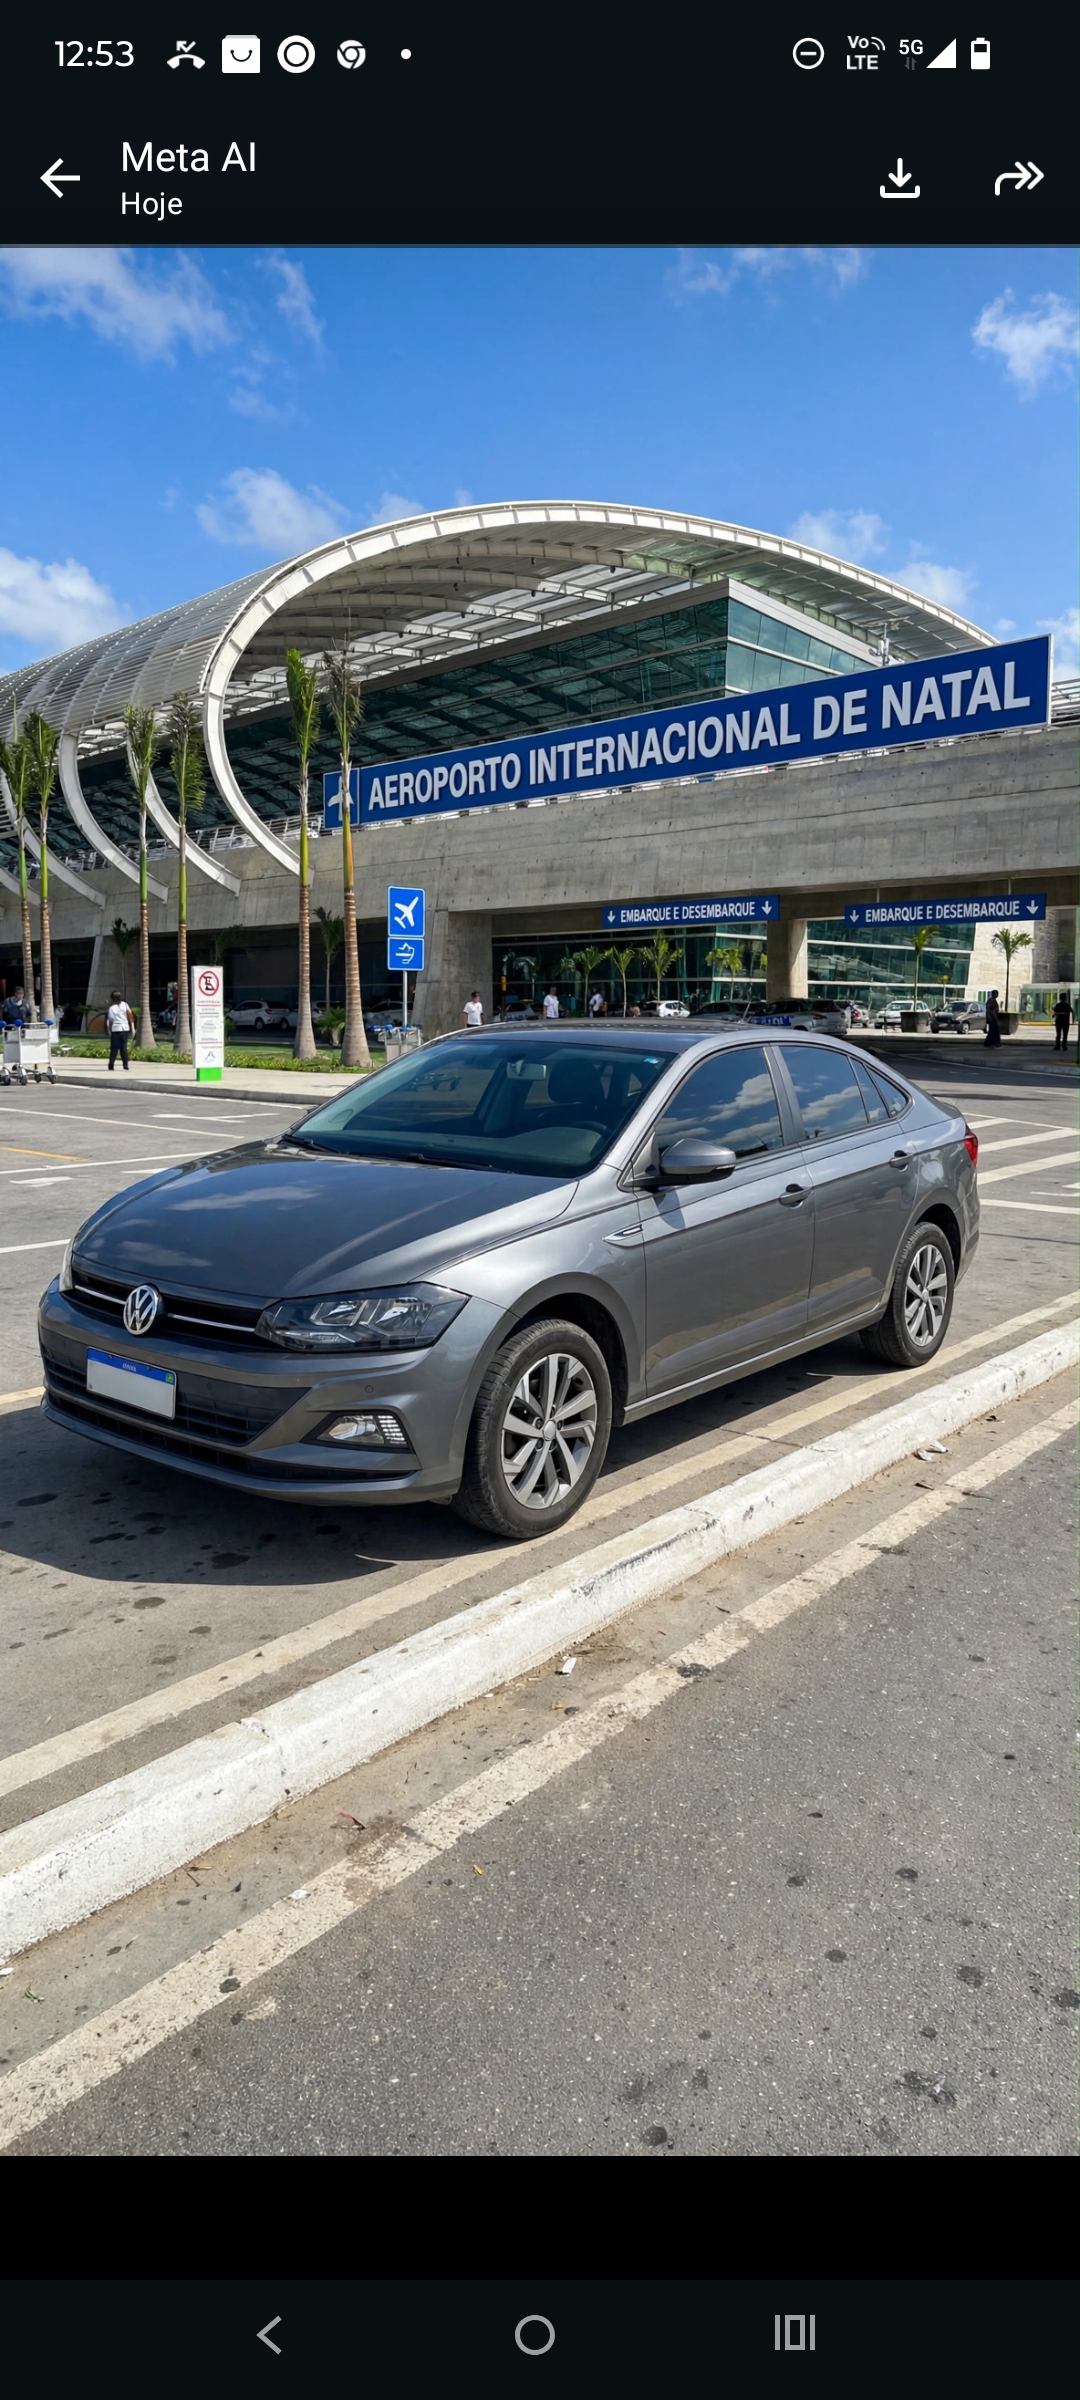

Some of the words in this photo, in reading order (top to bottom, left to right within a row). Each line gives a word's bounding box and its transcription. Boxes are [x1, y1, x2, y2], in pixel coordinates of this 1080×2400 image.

[368, 752, 521, 811] AEROPORTO
[529, 702, 801, 786] INTERNACIONAL
[813, 688, 868, 741] DE
[881, 661, 1031, 730] NATAL
[620, 906, 672, 924] EMBARQUE
[673, 906, 680, 920] E
[681, 901, 756, 920] DESEMBARQUE
[865, 905, 924, 923] EMBARQUE
[926, 904, 933, 920] E
[935, 900, 1020, 919] DESEMBARQUE
